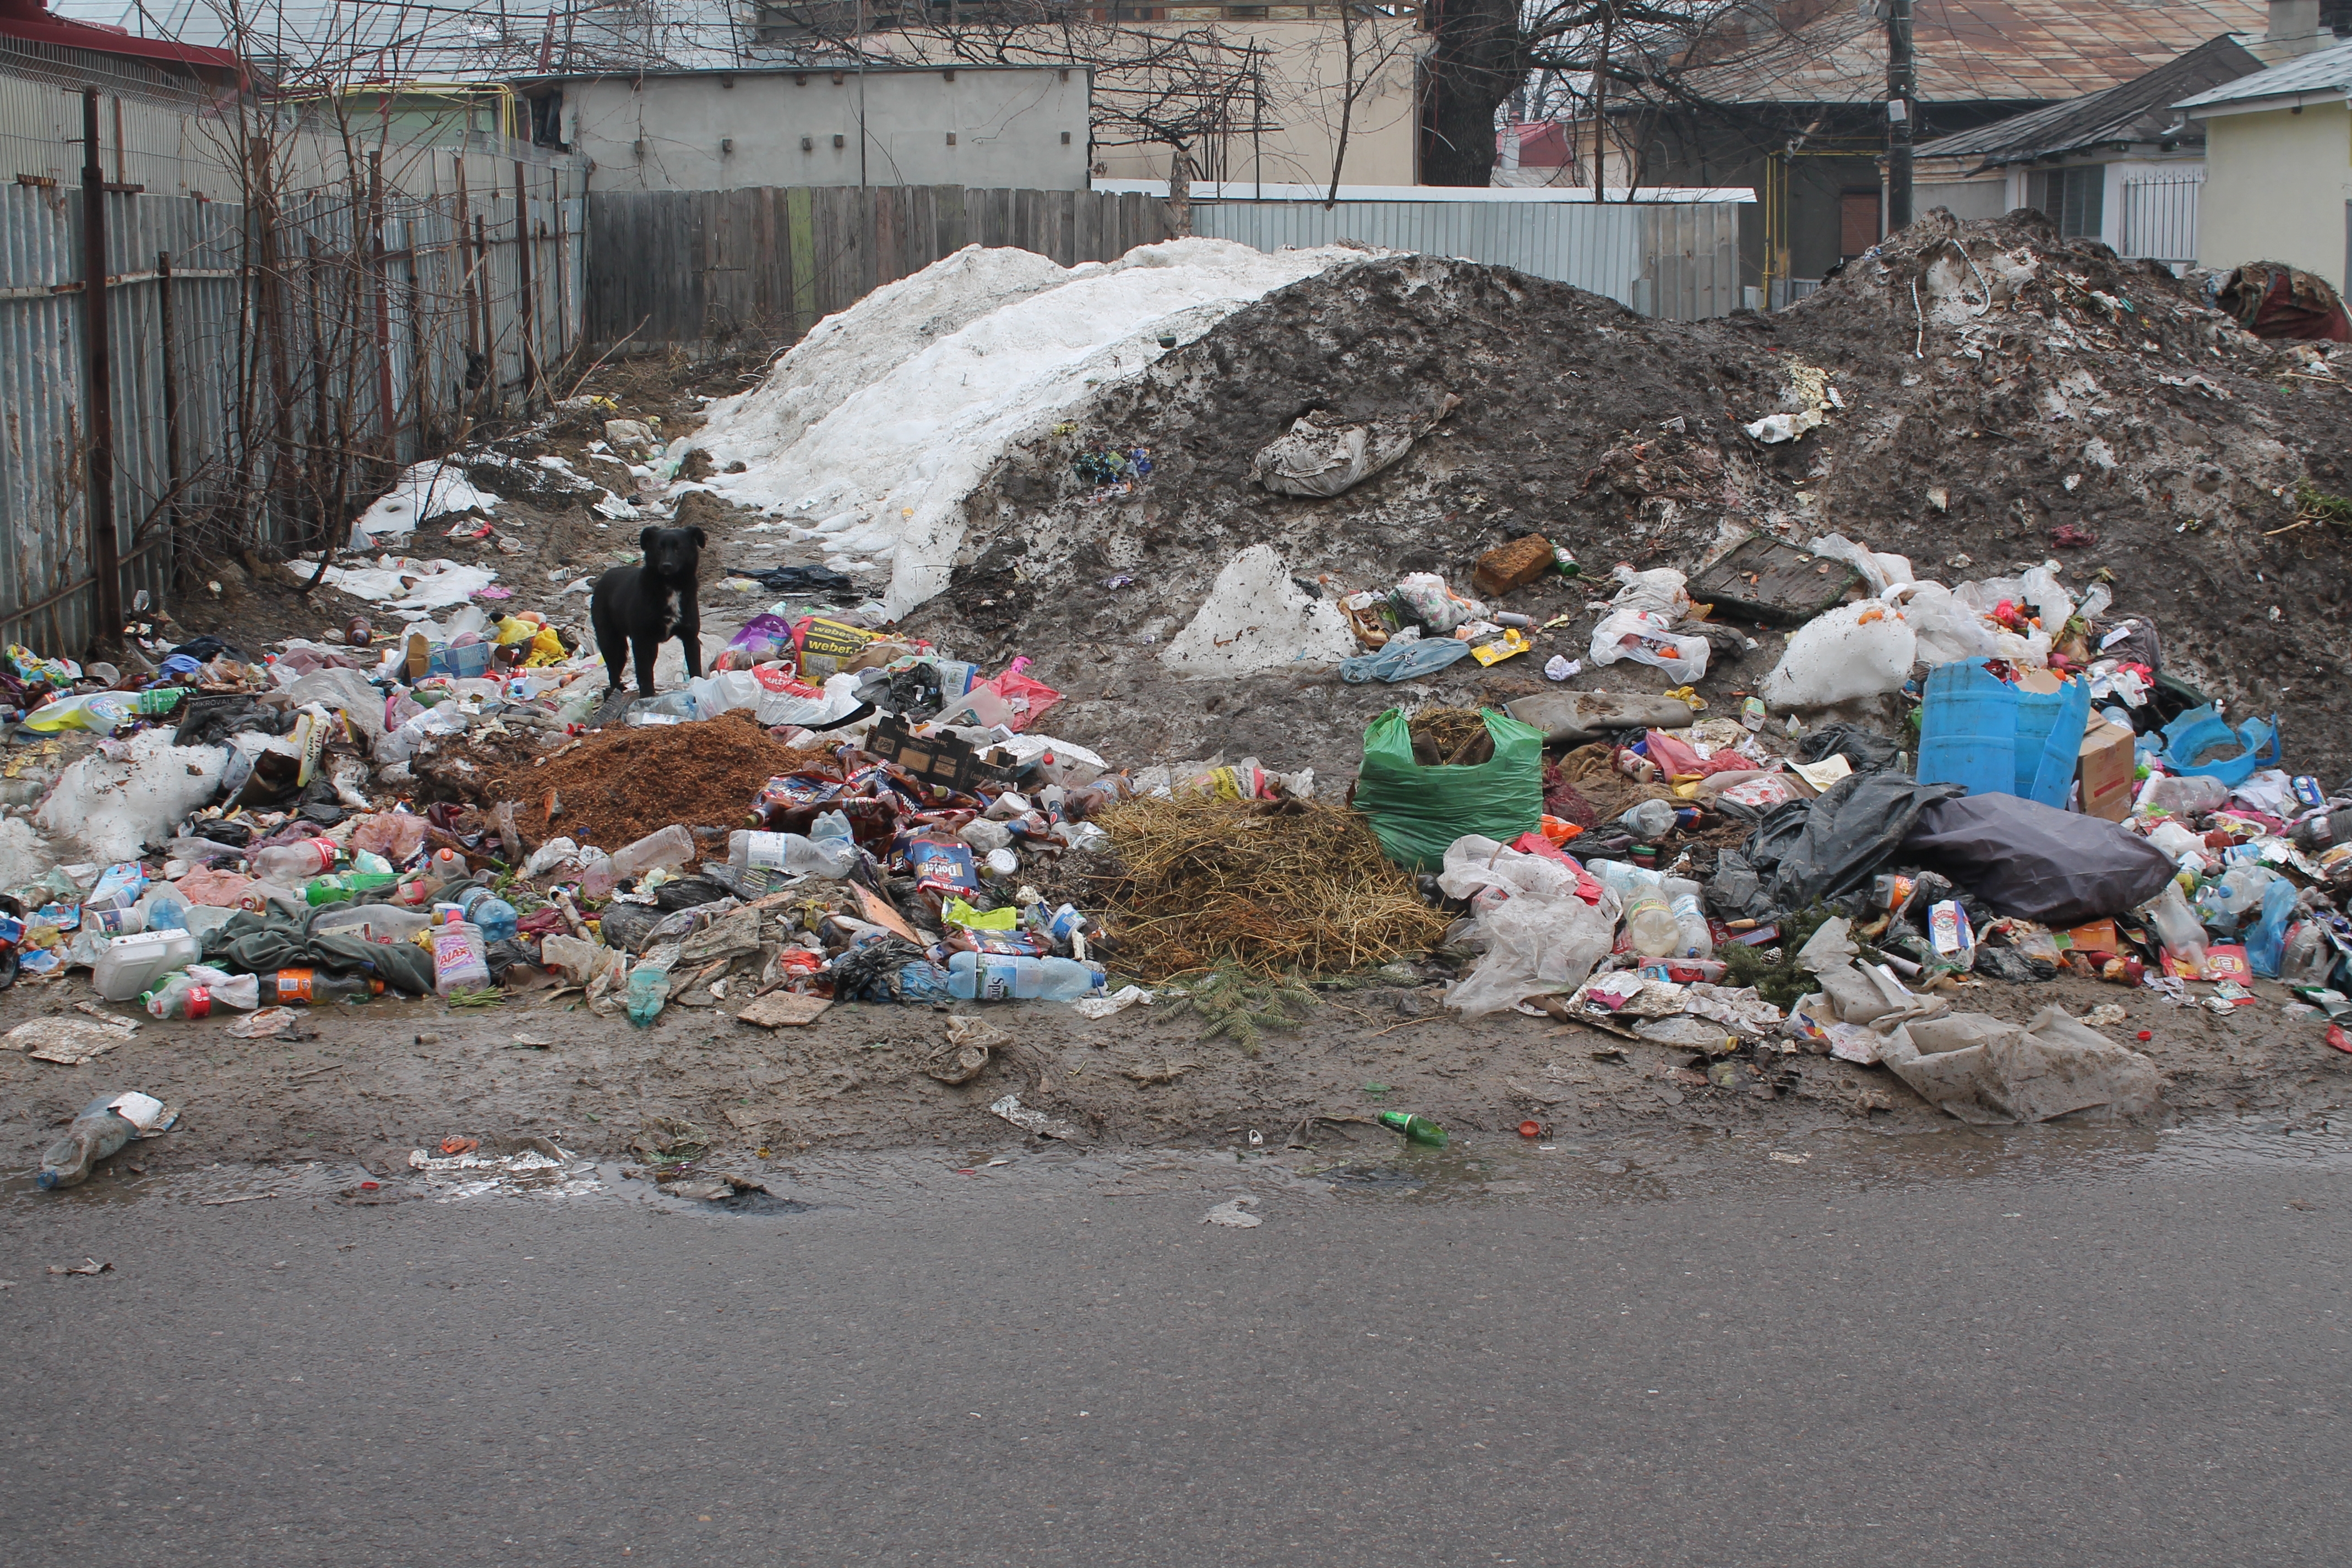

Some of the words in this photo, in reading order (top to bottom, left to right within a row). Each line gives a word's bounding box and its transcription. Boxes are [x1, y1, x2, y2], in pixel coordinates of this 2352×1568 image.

[192, 698, 235, 708] MIKROVAL
[923, 863, 958, 876] Dorfer
[439, 946, 470, 967] AJAX
